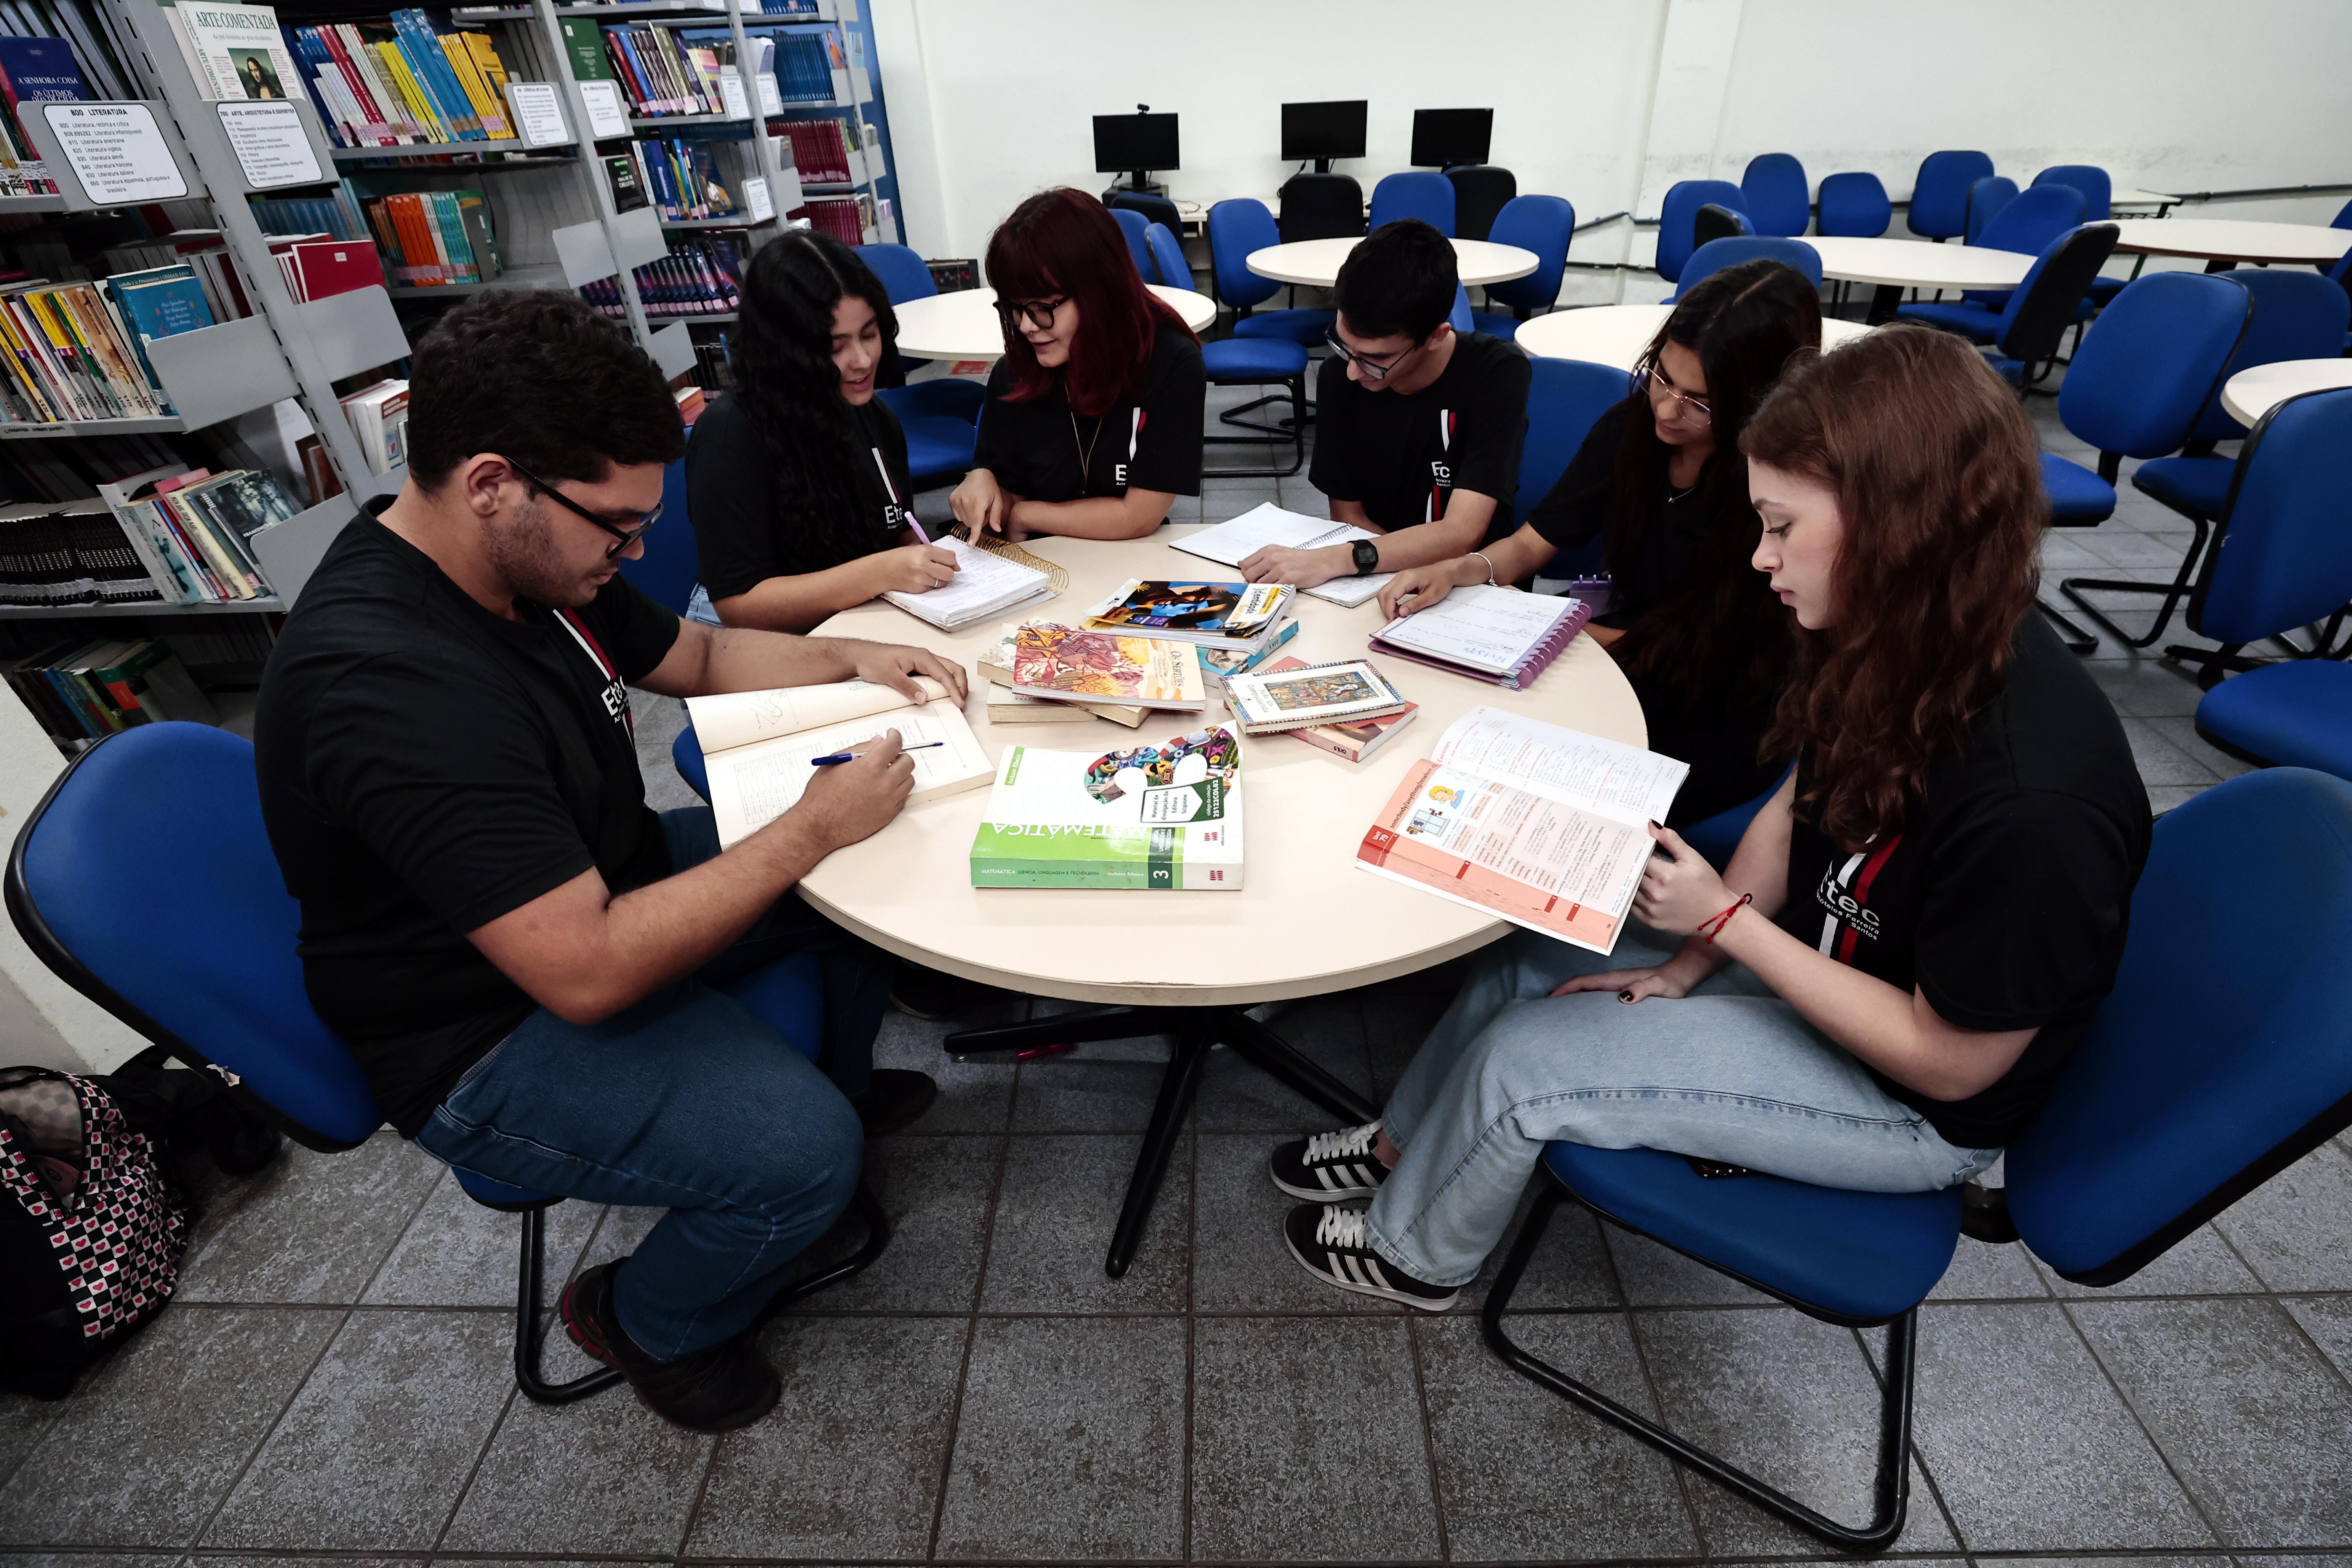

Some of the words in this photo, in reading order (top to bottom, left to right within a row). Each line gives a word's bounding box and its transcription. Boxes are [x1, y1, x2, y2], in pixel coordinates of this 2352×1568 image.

[196, 11, 222, 27] ARTE
[221, 12, 277, 29] COMENTADA
[198, 47, 208, 64] ARTE
[205, 64, 224, 99] COMENTAD
[43, 88, 73, 96] ÚLTIMOS
[1172, 661, 1184, 687] SERTÕES
[1361, 670, 1372, 682] Ariano
[1371, 681, 1386, 697] Suassuna
[1248, 684, 1269, 713] Compadecida
[1259, 689, 1267, 698] Auto
[1266, 698, 1273, 706] da
[1437, 741, 1451, 762] Exercises
[1007, 768, 1017, 785] Jackson
[1012, 753, 1022, 768] Ribeiro
[1390, 768, 1433, 829] somebody/anything/nowhere
[992, 823, 1149, 840] MATEMÁTICA
[1372, 831, 1382, 840] Unit
[1379, 834, 1389, 842] 79
[1153, 870, 1169, 880] 3
[1846, 913, 1879, 935] Ferreira
[1851, 922, 1877, 940] Santos
